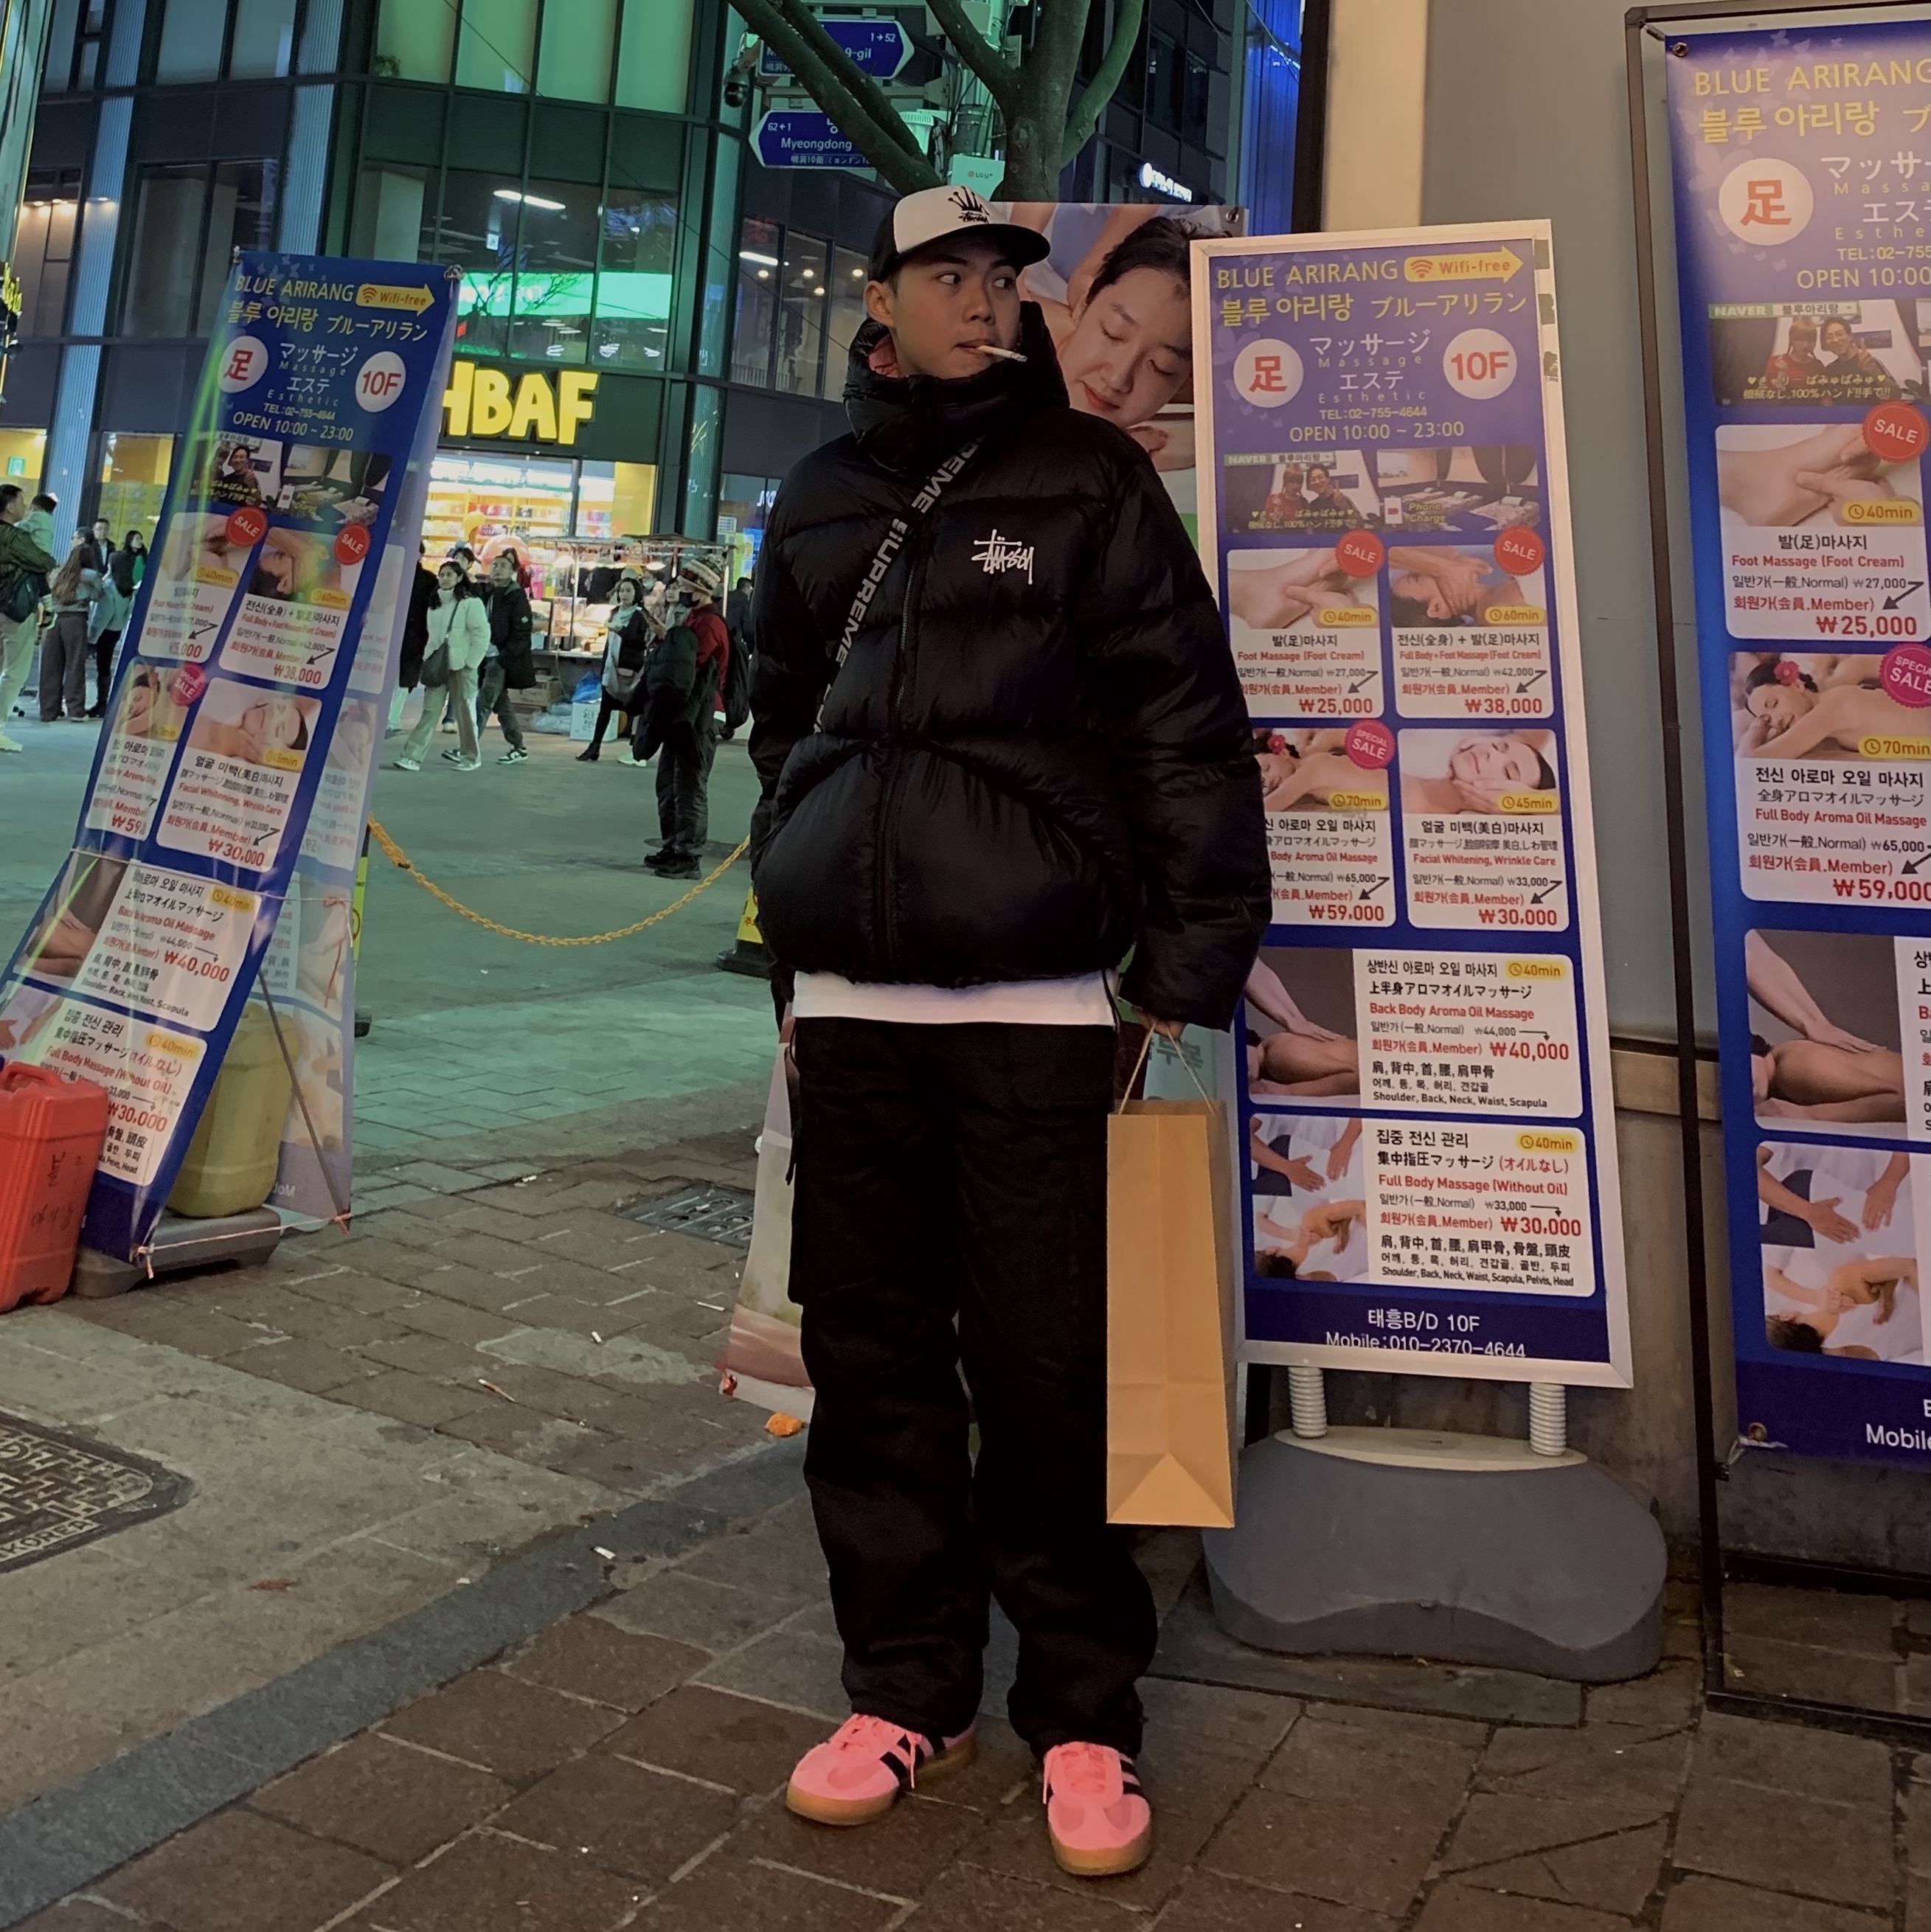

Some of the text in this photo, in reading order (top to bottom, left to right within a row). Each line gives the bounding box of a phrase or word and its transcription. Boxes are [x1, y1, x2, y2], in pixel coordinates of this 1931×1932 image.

[884, 34, 895, 42] 52
[845, 47, 871, 60] 9-gil
[1695, 68, 1771, 96] BLUE
[768, 122, 777, 131] 62
[1699, 100, 1880, 143] 블루 아리랑
[781, 138, 852, 151] Myeongdong
[1740, 179, 1793, 226] 足
[1217, 260, 1511, 289] BLUE ARIRANG Wifi-free
[1797, 268, 1859, 289] OPEN
[235, 276, 276, 296] BLUE
[281, 282, 354, 302] ARIRANG
[1220, 293, 1354, 327] 블루 아리랑
[1371, 293, 1527, 319] ブルーアリラン
[1715, 306, 1767, 316] NAVER
[228, 301, 319, 332] 블루 아리랑
[327, 315, 428, 341] ブルーアリラン
[1309, 329, 1431, 355] マッサージ
[280, 342, 358, 366] マッサージ
[1319, 354, 1422, 368] Massage
[223, 350, 253, 381] 足
[1249, 355, 1287, 392] 足
[1451, 352, 1509, 380] 10F
[287, 377, 330, 395] エステ
[362, 370, 401, 396] 10F
[1339, 370, 1404, 390] エステ
[1319, 392, 1426, 403] Esthetic
[232, 411, 354, 441] OPEN 10:00 23:00
[1289, 421, 1464, 442] OPEN 10:00 23:00
[1874, 419, 1918, 444] SALE
[1867, 505, 1913, 519] 40min
[235, 516, 260, 537] SALE
[341, 533, 363, 553] SALE
[1502, 540, 1536, 561] SALE
[1778, 535, 1867, 550] 발(足)마사지
[1343, 543, 1377, 564] SALE
[1732, 555, 1758, 566] Foot
[1763, 555, 1817, 569] Massage
[1337, 611, 1372, 622] 40min
[1504, 610, 1539, 621] 60min
[1272, 635, 1337, 647] 발(足)마사지
[1471, 633, 1539, 646] 발(足)마사지
[1238, 652, 1257, 660] Foot
[1261, 652, 1300, 662] Massage
[1351, 740, 1386, 760] SALE
[1883, 741, 1930, 755] 70min
[1756, 768, 1924, 788] 전신 아로마 오일 마사지
[1347, 796, 1381, 807] 70min
[1516, 797, 1553, 808] 45min
[1279, 819, 1376, 832] 아로마 오일 마사지
[1421, 821, 1445, 833] 얼굴
[1755, 808, 1927, 829] Full Body Aroma Oil Massage
[1271, 852, 1378, 864] Body Aroma Oil Massage
[1413, 854, 1556, 866] Facial Whitening, Wrinkle Care
[1367, 959, 1497, 977] 상반신 아로마 오일 마사지
[1370, 1002, 1534, 1021] Back Body Aroma Oil Massage
[1373, 1091, 1419, 1103] Shoulder,
[1421, 1094, 1447, 1104] Back,
[1509, 1098, 1547, 1109] Scapula
[1377, 1129, 1469, 1148] 집중 전신 관리
[1379, 1174, 1401, 1186] Full
[1404, 1175, 1435, 1190] Body
[1438, 1178, 1489, 1192] Massage
[1447, 1315, 1480, 1332] 10F
